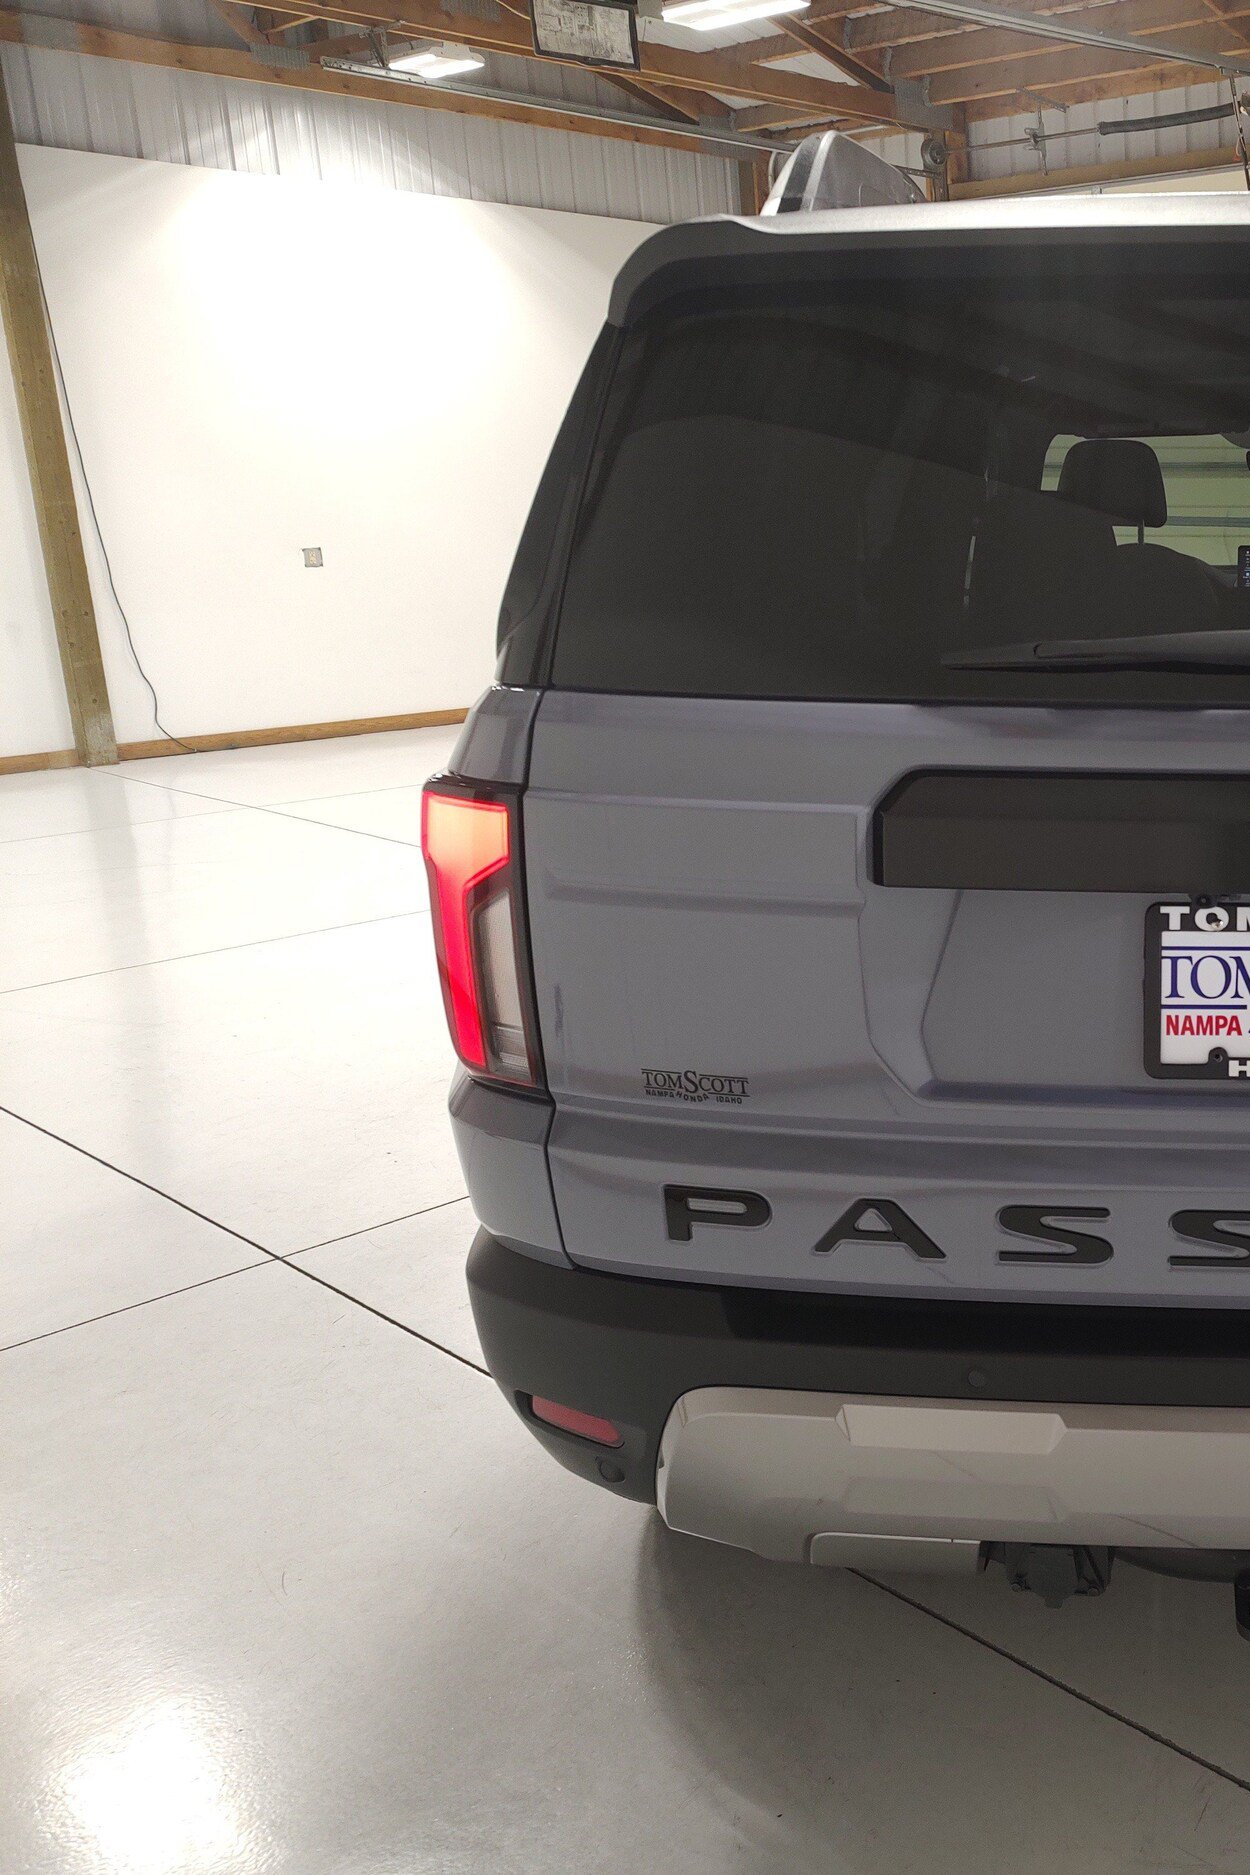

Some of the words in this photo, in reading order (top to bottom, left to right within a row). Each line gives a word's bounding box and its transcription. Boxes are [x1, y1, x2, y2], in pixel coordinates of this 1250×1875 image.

[1165, 1014, 1242, 1036] NAMPA
[645, 1089, 675, 1099] NAMPA
[675, 1091, 710, 1103] HONDA
[716, 1096, 743, 1105] IDAHO
